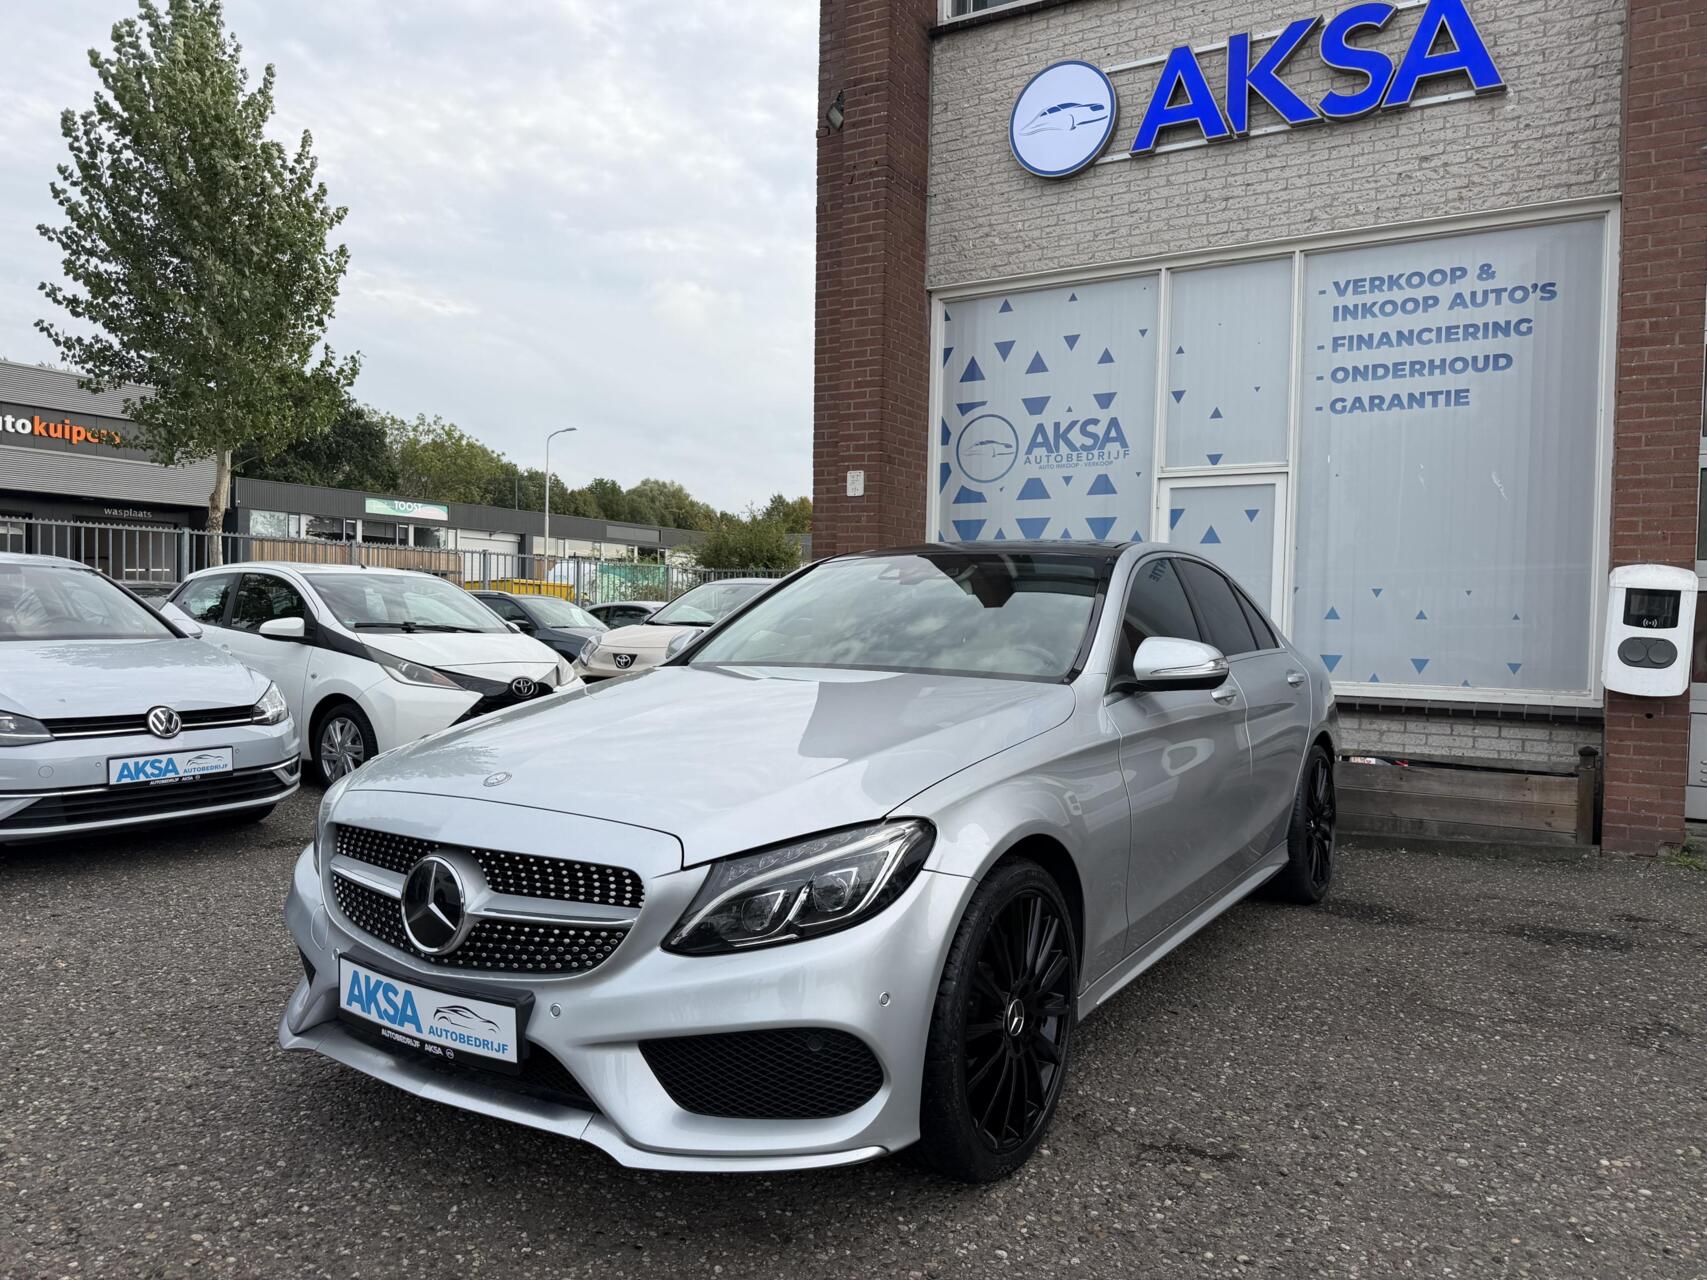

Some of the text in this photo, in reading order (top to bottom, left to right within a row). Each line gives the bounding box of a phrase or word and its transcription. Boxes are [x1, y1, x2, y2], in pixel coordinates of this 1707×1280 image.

[1130, 0, 1507, 157] AKSA
[1332, 266, 1468, 298] VERKOOP
[1476, 263, 1497, 282] &
[1332, 282, 1558, 322] INKOOP AUTO'S
[1332, 318, 1534, 353] FINANCIERING
[1330, 353, 1514, 384] ONDERHOUD
[1329, 388, 1471, 415] GARANTIE
[1024, 416, 1130, 456] AKSA
[1024, 449, 1131, 466] AUTOBEDRIJF
[104, 507, 152, 519] wasplaats
[394, 500, 421, 512] TOOST
[116, 757, 180, 783] AKSA
[183, 764, 228, 774] AUTOBEDRIJF
[346, 970, 424, 1034] AKSA
[381, 1028, 444, 1057] AUTOBEDRIJF AKSA
[428, 1025, 509, 1055] AUTOBEDRIJF
